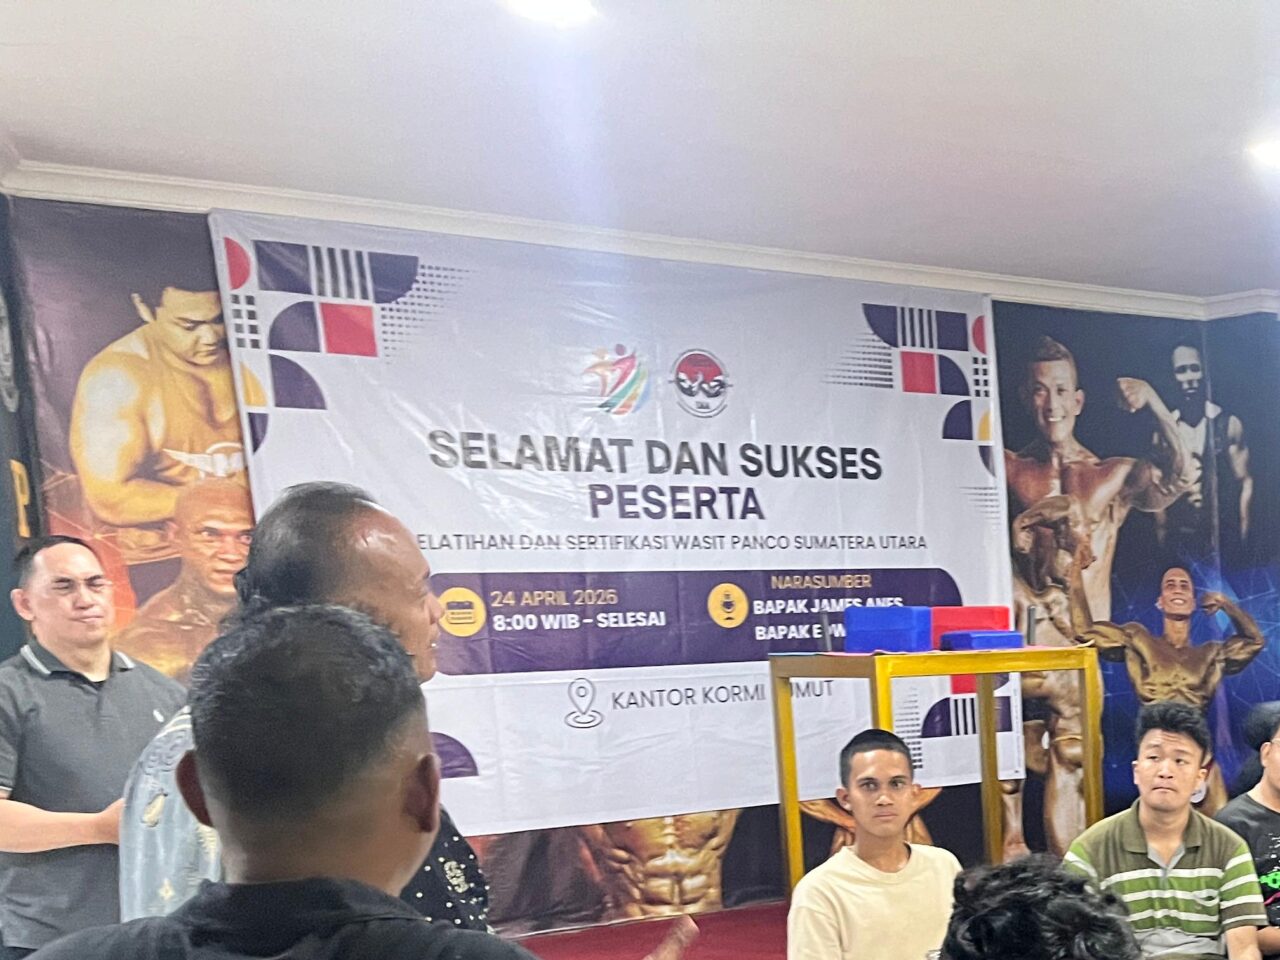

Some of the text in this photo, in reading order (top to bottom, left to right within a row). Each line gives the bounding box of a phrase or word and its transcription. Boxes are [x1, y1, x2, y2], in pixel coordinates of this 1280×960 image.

[428, 430, 882, 480] SELAMAT DAN SUKSES
[588, 484, 766, 520] PESERTA
[416, 534, 927, 550] ELATIHAN DAN SERTIFIKASI WASIT PANCO SUMATERA UTARA
[771, 574, 872, 589] NARASUMBER
[490, 589, 618, 607] 24 APRIL 2026
[753, 600, 808, 615] BAPAK
[811, 598, 862, 613] JAMES
[493, 614, 538, 631] 8:00
[541, 613, 580, 630] WIB
[597, 611, 666, 628] SELESAI
[755, 625, 810, 640] BAPAK
[611, 680, 834, 710] KANTOR KORMI MUT
